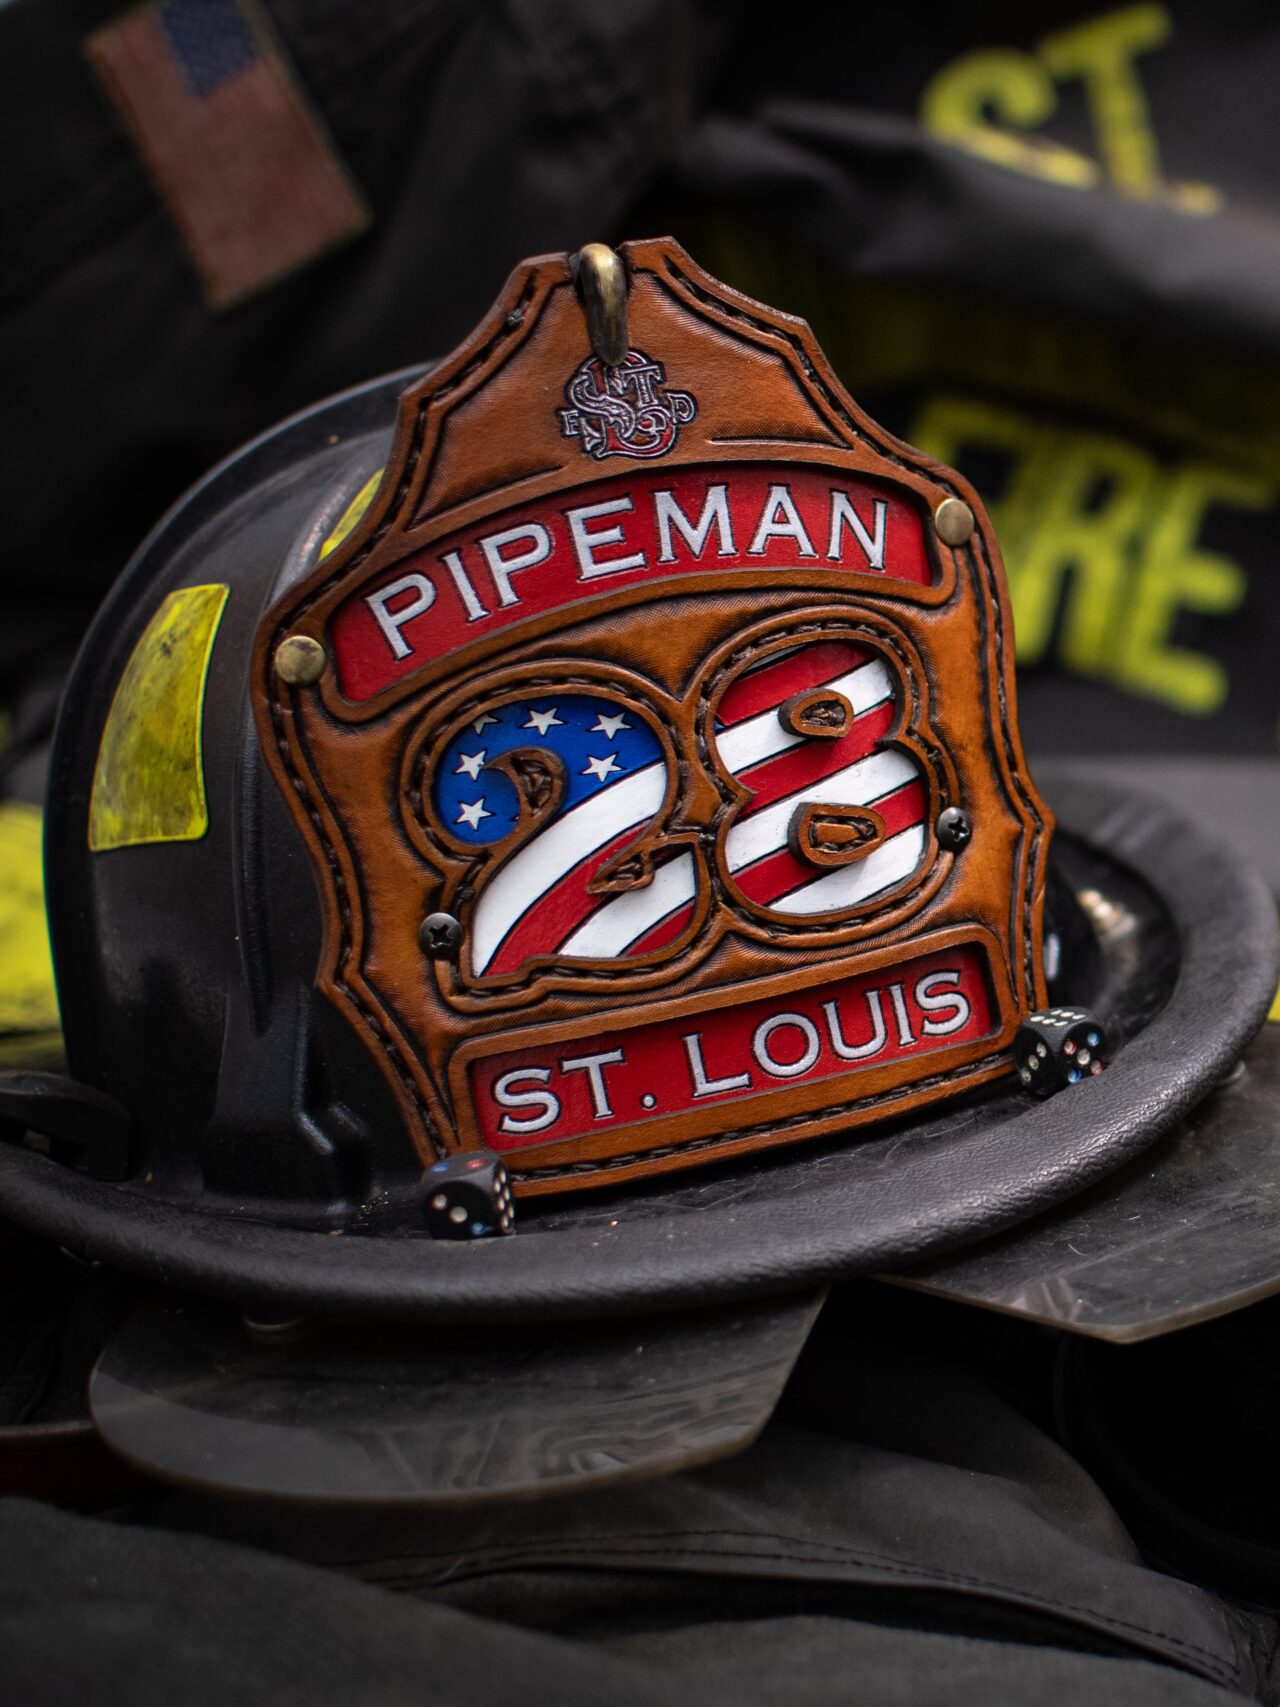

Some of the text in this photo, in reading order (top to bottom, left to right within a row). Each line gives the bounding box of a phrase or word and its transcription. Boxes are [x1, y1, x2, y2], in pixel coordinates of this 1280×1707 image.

[364, 483, 888, 661] PIPEMAN
[432, 640, 932, 980] 28
[491, 970, 973, 1136] ST. LOUIS
